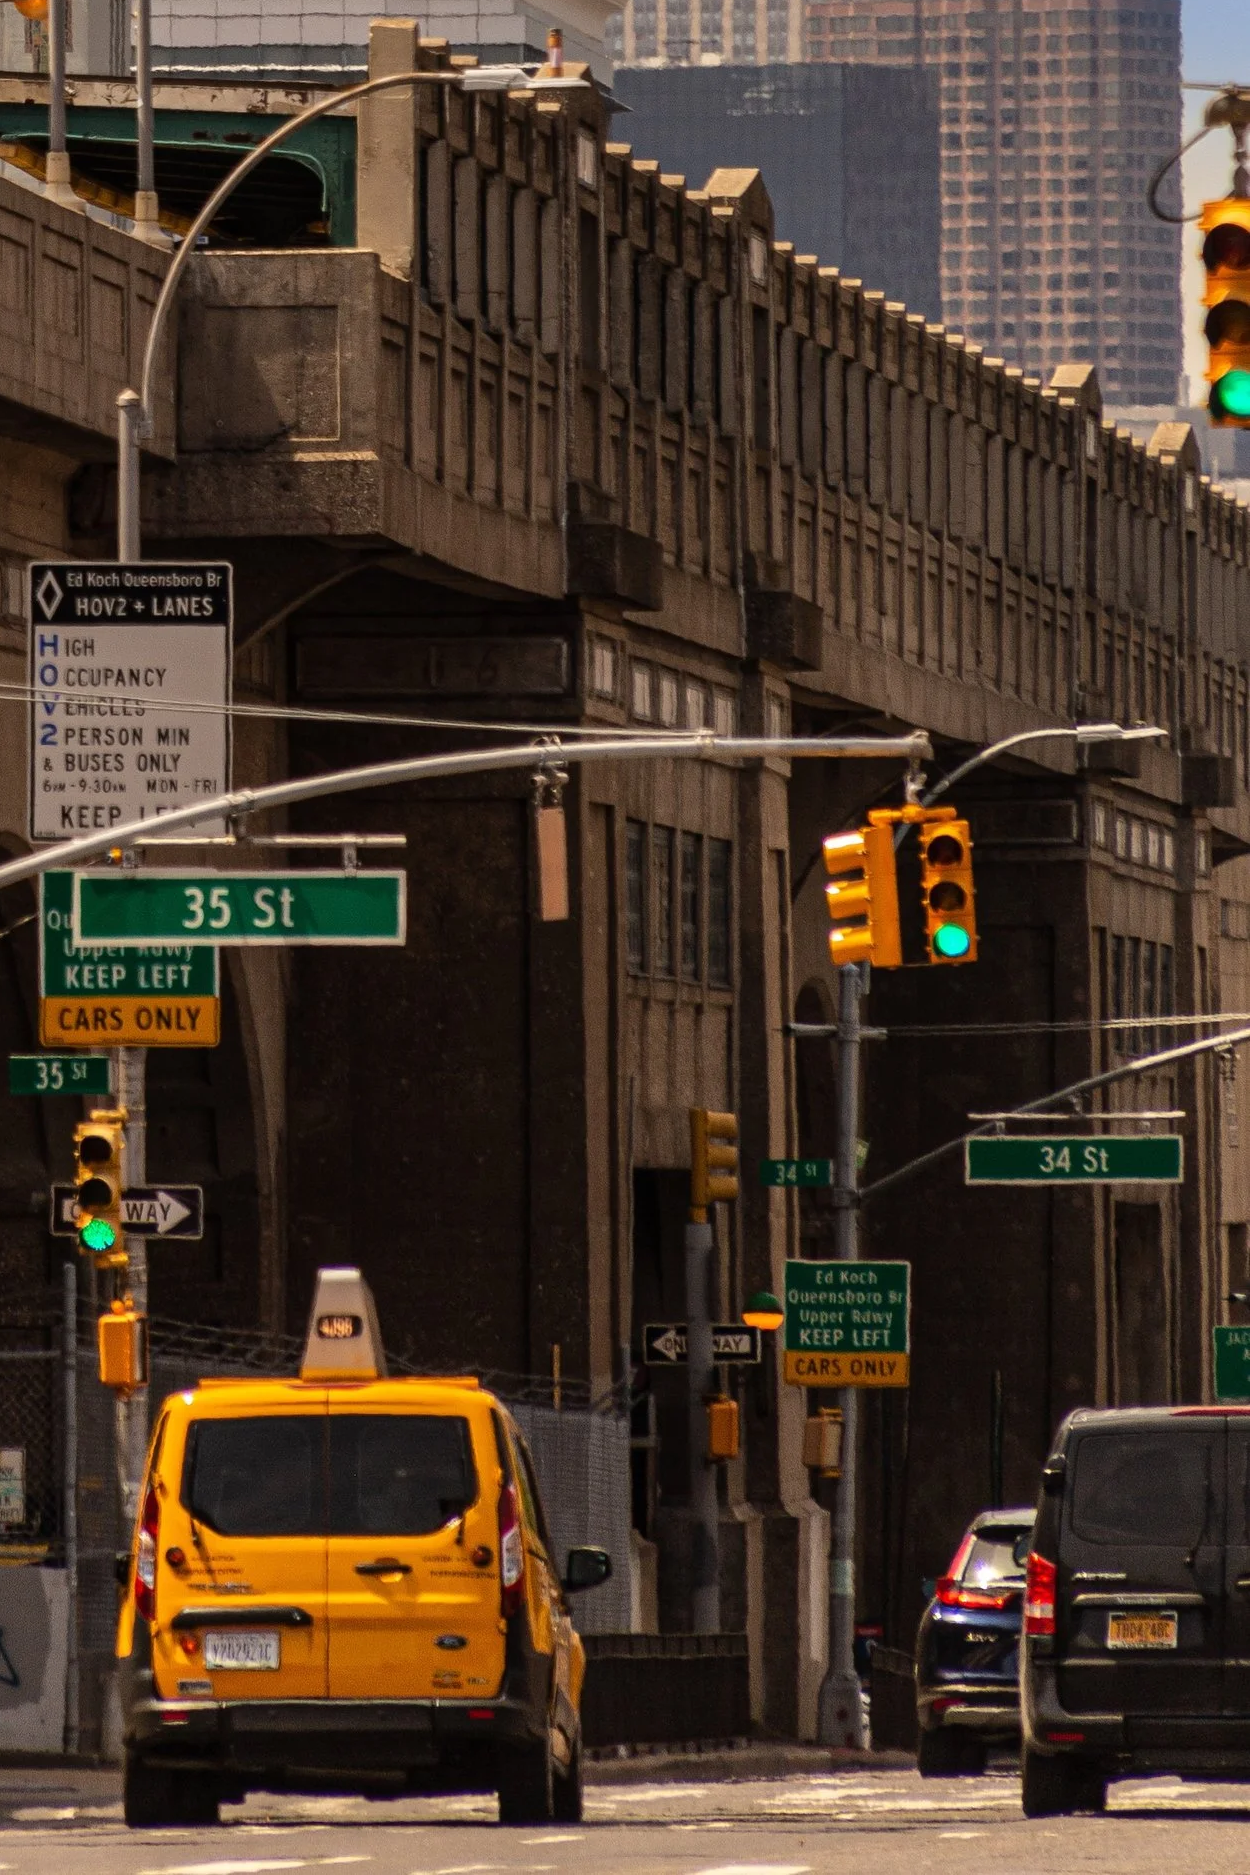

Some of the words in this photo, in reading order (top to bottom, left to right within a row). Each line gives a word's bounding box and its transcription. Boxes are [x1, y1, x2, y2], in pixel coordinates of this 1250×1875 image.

[67, 572, 83, 587] Ed
[88, 572, 120, 587] Koch
[124, 572, 203, 588] Queensboro
[207, 572, 222, 587] Br
[76, 597, 126, 616] HOV2
[152, 597, 213, 616] LANES
[65, 728, 143, 746] PERSON
[157, 728, 190, 746] MIN
[43, 758, 53, 771] &
[65, 753, 125, 772] BUSES
[137, 754, 181, 772] ONLY
[61, 806, 121, 829] KEEP
[182, 886, 231, 929] 35
[252, 886, 295, 928] St
[64, 964, 126, 989] KEEP
[137, 964, 193, 989] LEFT
[59, 1007, 124, 1031] CARS
[135, 1007, 201, 1031] ONLY
[35, 1061, 64, 1090] 35
[1038, 1145, 1071, 1173] 34
[1082, 1145, 1110, 1173] St
[775, 1163, 797, 1184] 34
[125, 1203, 171, 1221] WAY
[815, 1270, 833, 1284] Ed
[839, 1270, 878, 1284] Koch
[788, 1289, 883, 1305] Queensboro
[799, 1309, 845, 1325] Upper
[851, 1309, 893, 1328] Rdwy
[799, 1329, 845, 1346] KEEP
[853, 1329, 892, 1346] LEFT
[794, 1358, 842, 1376] CARS
[850, 1358, 897, 1376] ONLY
